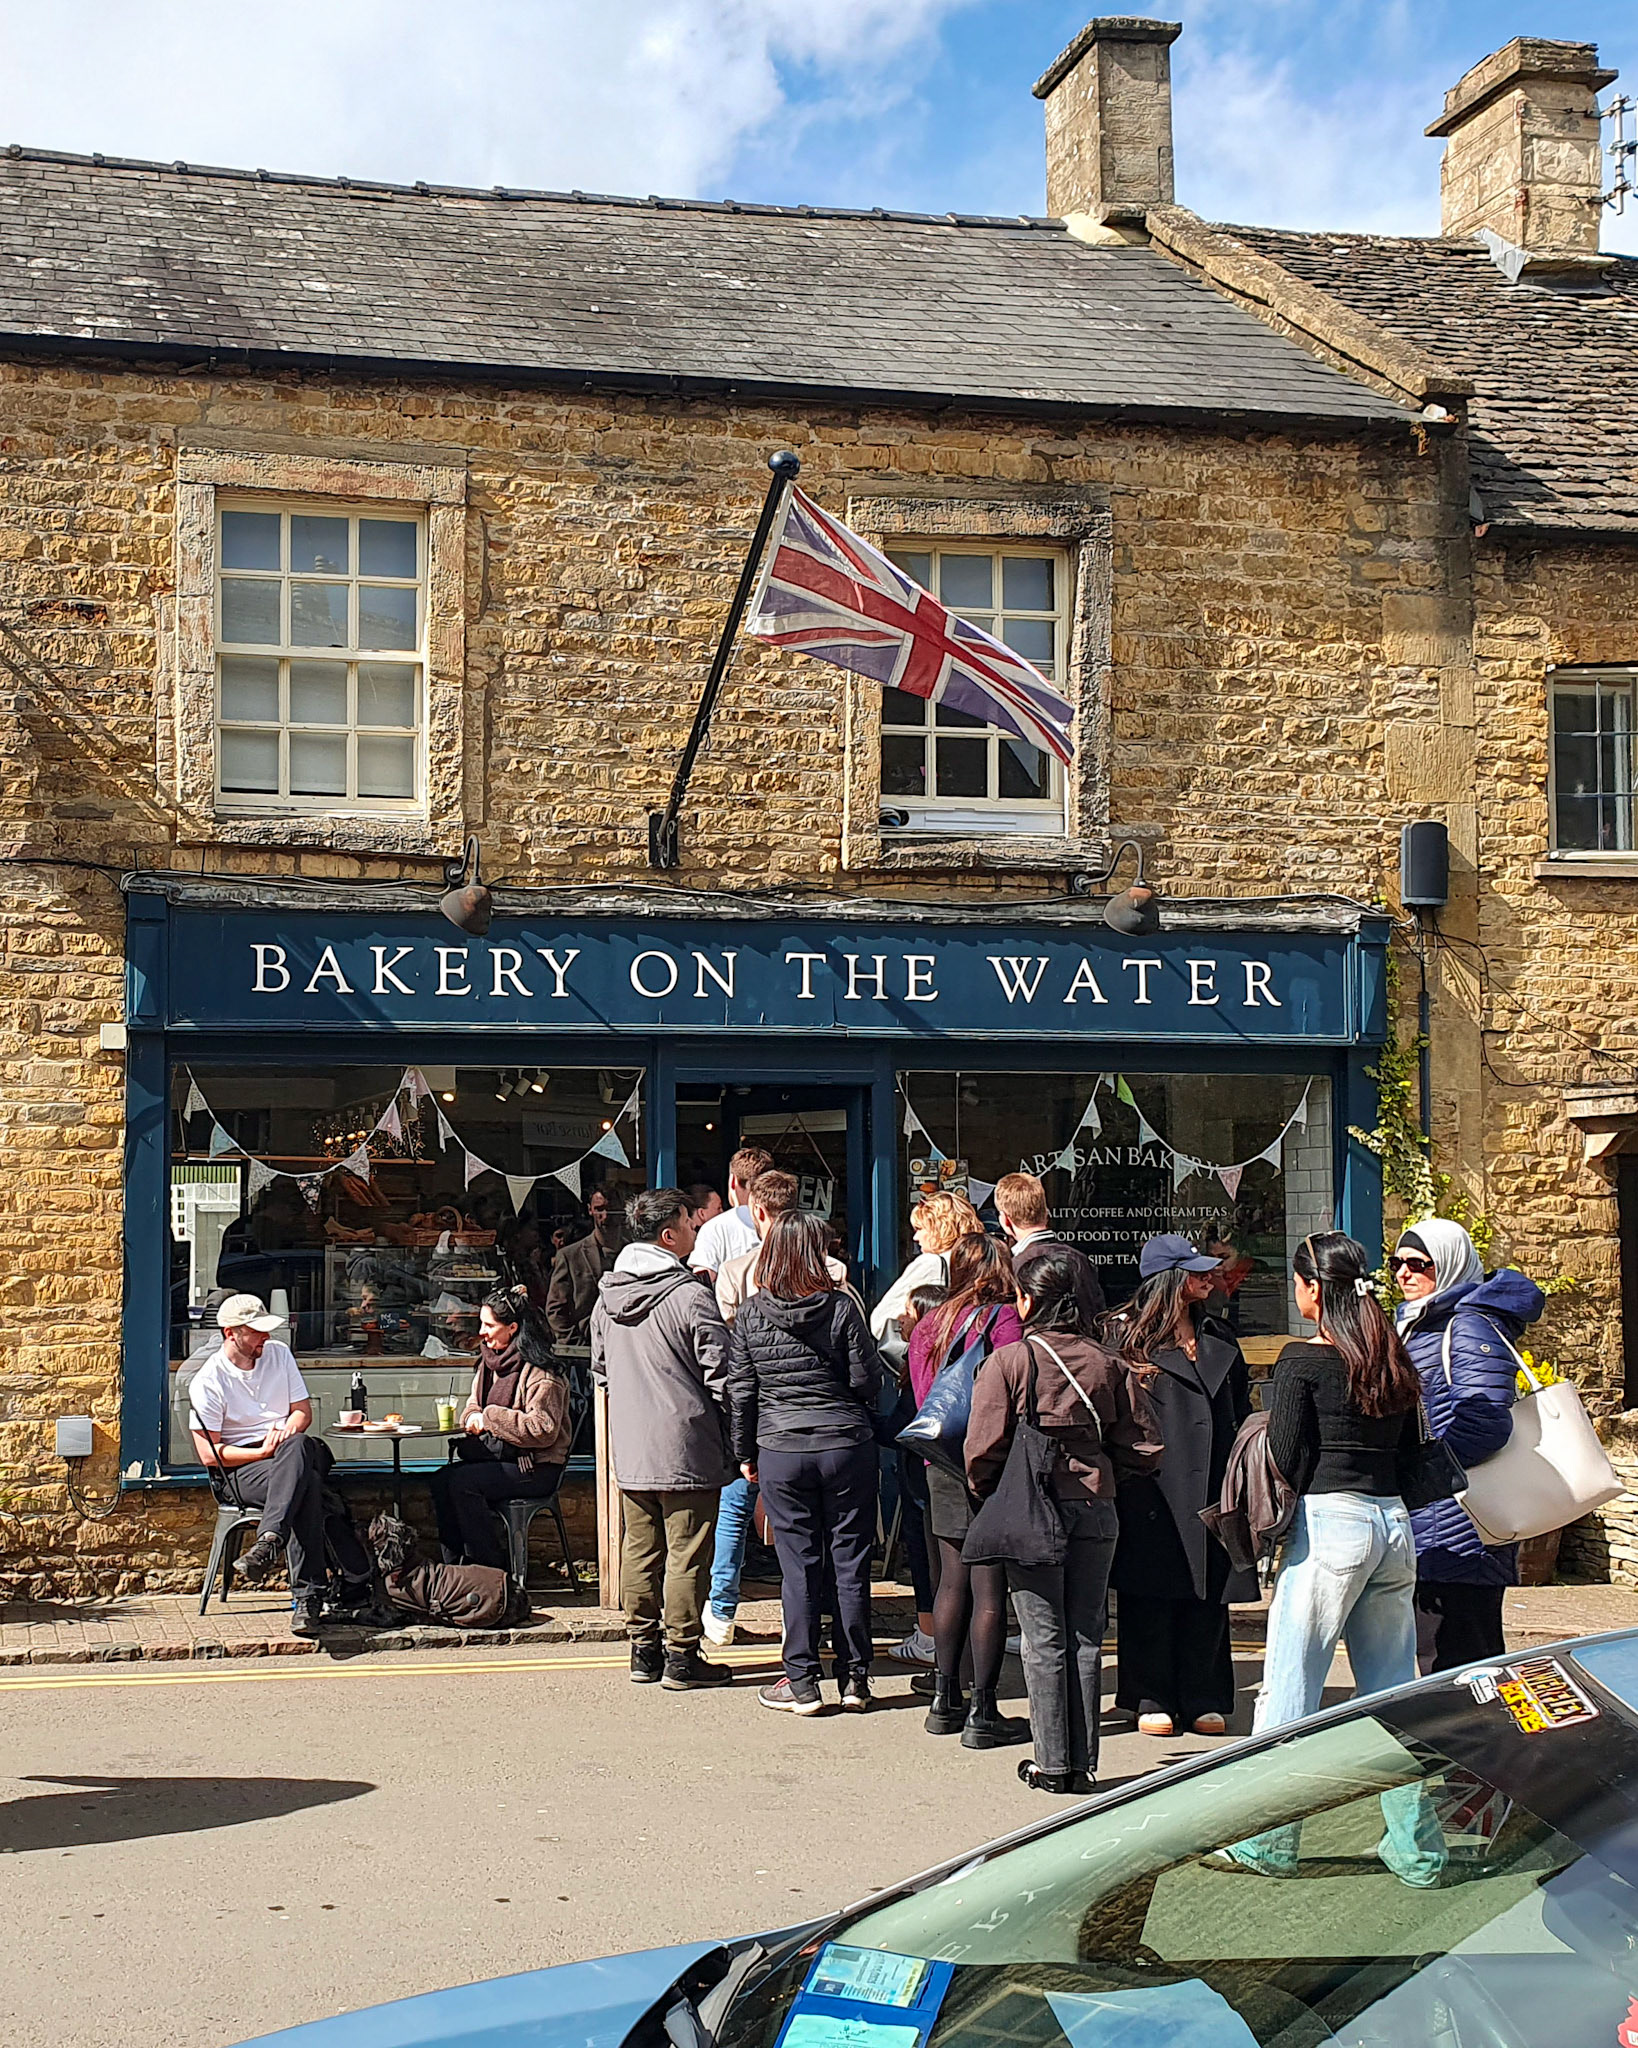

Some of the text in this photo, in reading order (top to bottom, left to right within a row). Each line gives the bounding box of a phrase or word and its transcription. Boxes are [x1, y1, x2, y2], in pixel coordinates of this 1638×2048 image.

[250, 943, 1284, 1008] BAKERY ON THE WATER
[1019, 1146, 1122, 1175] ARTSAN
[797, 1175, 834, 1216] EN
[1046, 1206, 1228, 1218] ALITY COFFEE AND CREAM TEAS
[1077, 1230, 1111, 1241] FOOD
[1112, 1230, 1130, 1241] TO
[1115, 1254, 1139, 1265] TEA
[1511, 1658, 1593, 1724] POWERFLEX
